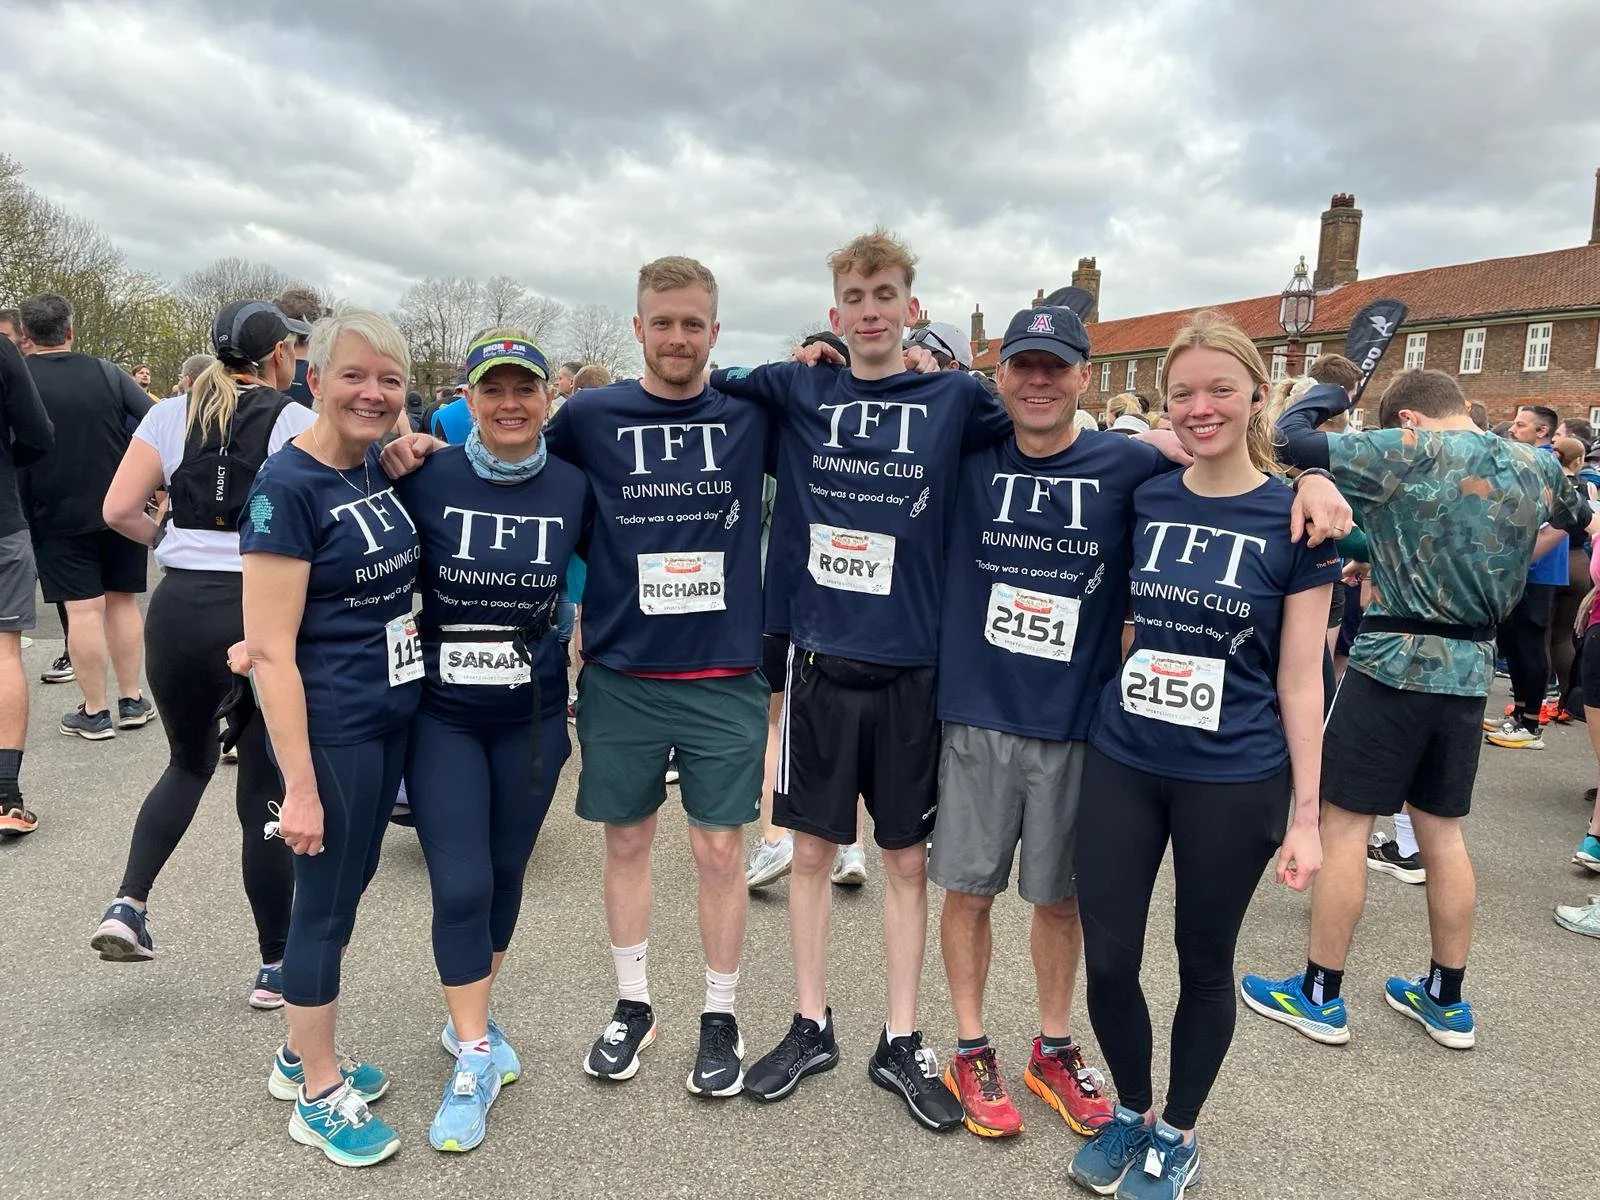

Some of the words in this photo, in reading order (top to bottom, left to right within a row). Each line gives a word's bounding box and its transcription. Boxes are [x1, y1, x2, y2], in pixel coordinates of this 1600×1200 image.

[1027, 313, 1055, 335] A
[818, 400, 928, 454] TFT
[617, 423, 728, 475] TFT
[812, 454, 880, 476] RUNNING
[884, 461, 924, 479] CLUB
[215, 465, 226, 502] EVADICT
[622, 482, 693, 500] RUNNING
[696, 480, 732, 496] CLUB
[830, 490, 846, 499] was
[848, 492, 856, 500] a
[857, 493, 884, 503] good
[992, 473, 1100, 531] TFT
[329, 485, 417, 556] TFT
[647, 514, 664, 523] was
[667, 514, 674, 522] a
[676, 511, 702, 523] good
[443, 505, 564, 565] TFT
[982, 530, 1053, 552] RUNNING
[1056, 539, 1099, 557] CLUB
[355, 548, 413, 584] RUNNING
[819, 552, 881, 578] RORY
[1140, 521, 1267, 589] TFT
[439, 565, 517, 587] RUNNING
[521, 573, 558, 588] CLUB
[1001, 565, 1019, 574] was
[1021, 567, 1028, 576] a
[1030, 569, 1058, 578] good
[642, 581, 722, 598] RICHARD
[1130, 580, 1200, 605] RUNNING
[1203, 593, 1251, 618] CLUB
[480, 599, 488, 607] a
[490, 600, 517, 608] good
[992, 605, 1066, 647] 2151
[1146, 617, 1162, 627] was
[1165, 620, 1173, 629] a
[1175, 622, 1204, 634] good
[447, 650, 524, 670] SARAH
[1126, 671, 1216, 712] 2150
